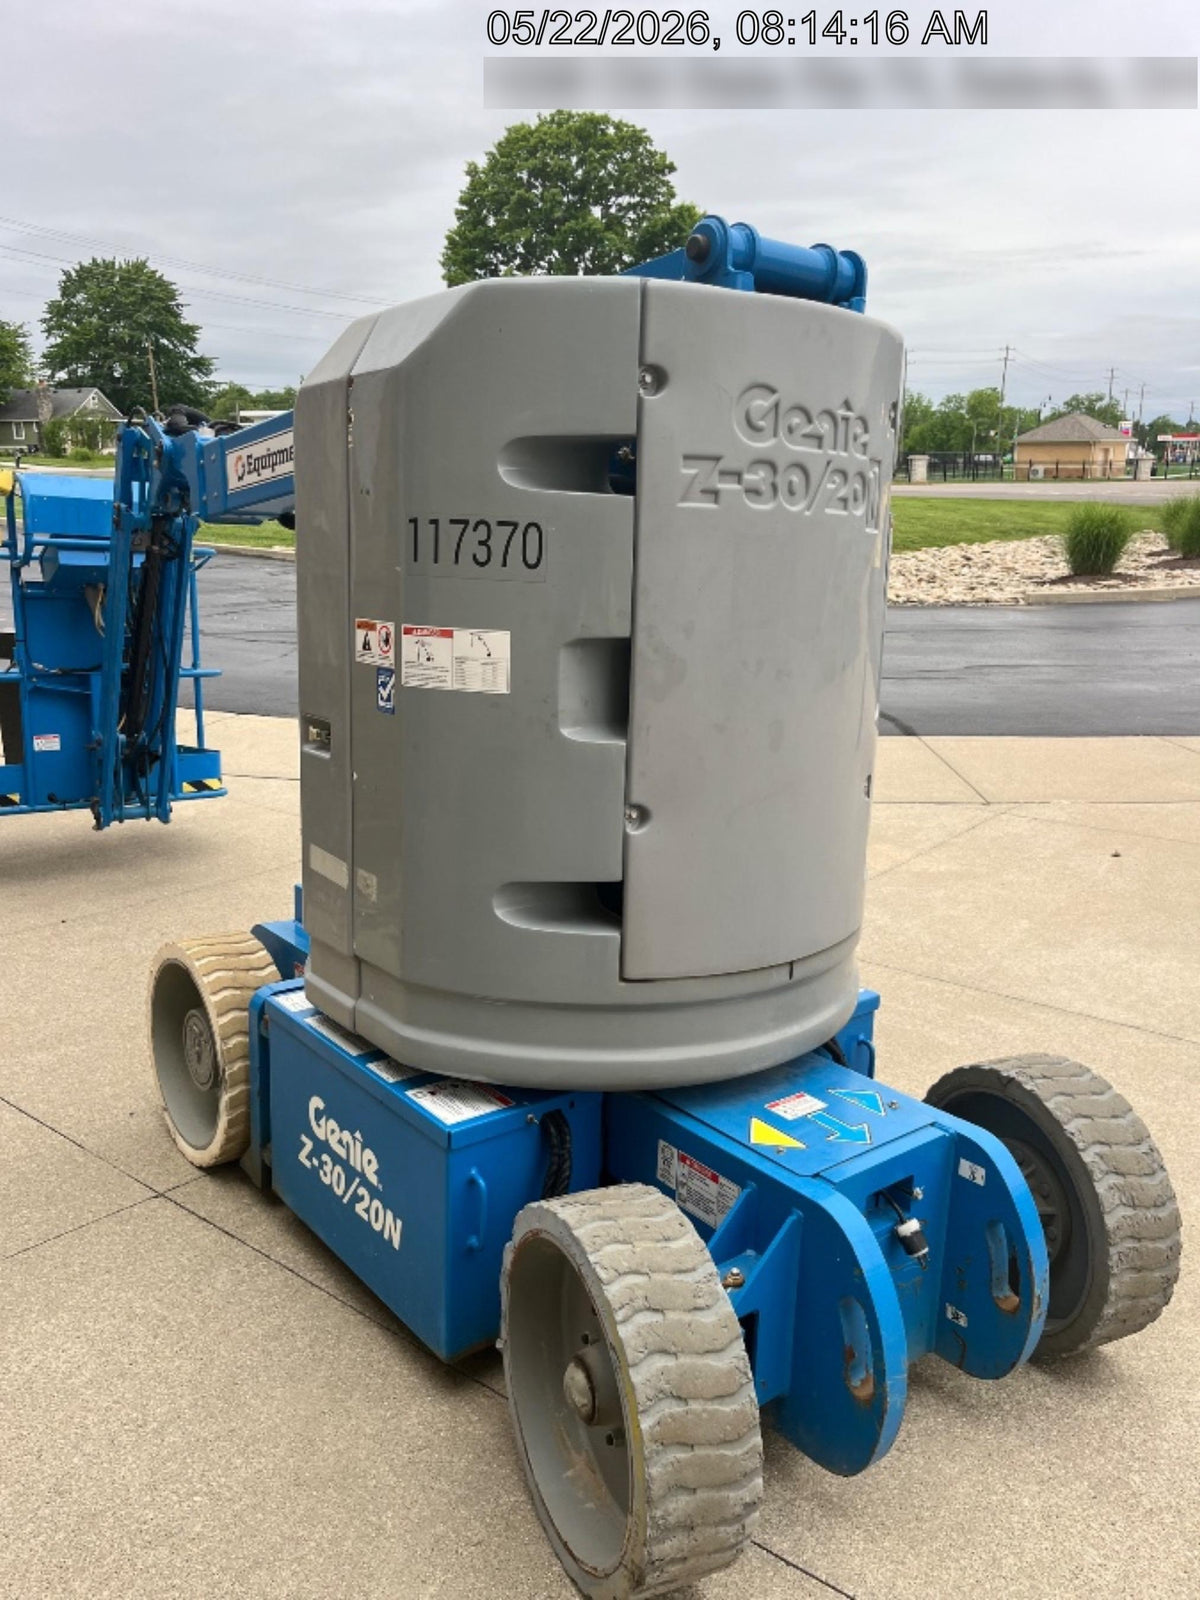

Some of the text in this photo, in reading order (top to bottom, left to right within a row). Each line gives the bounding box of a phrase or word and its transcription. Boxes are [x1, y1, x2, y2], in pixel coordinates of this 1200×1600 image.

[734, 382, 870, 460] Genie
[408, 516, 543, 570] 117370
[308, 1095, 379, 1187] Genie
[298, 1133, 403, 1251] Z-30/20N
